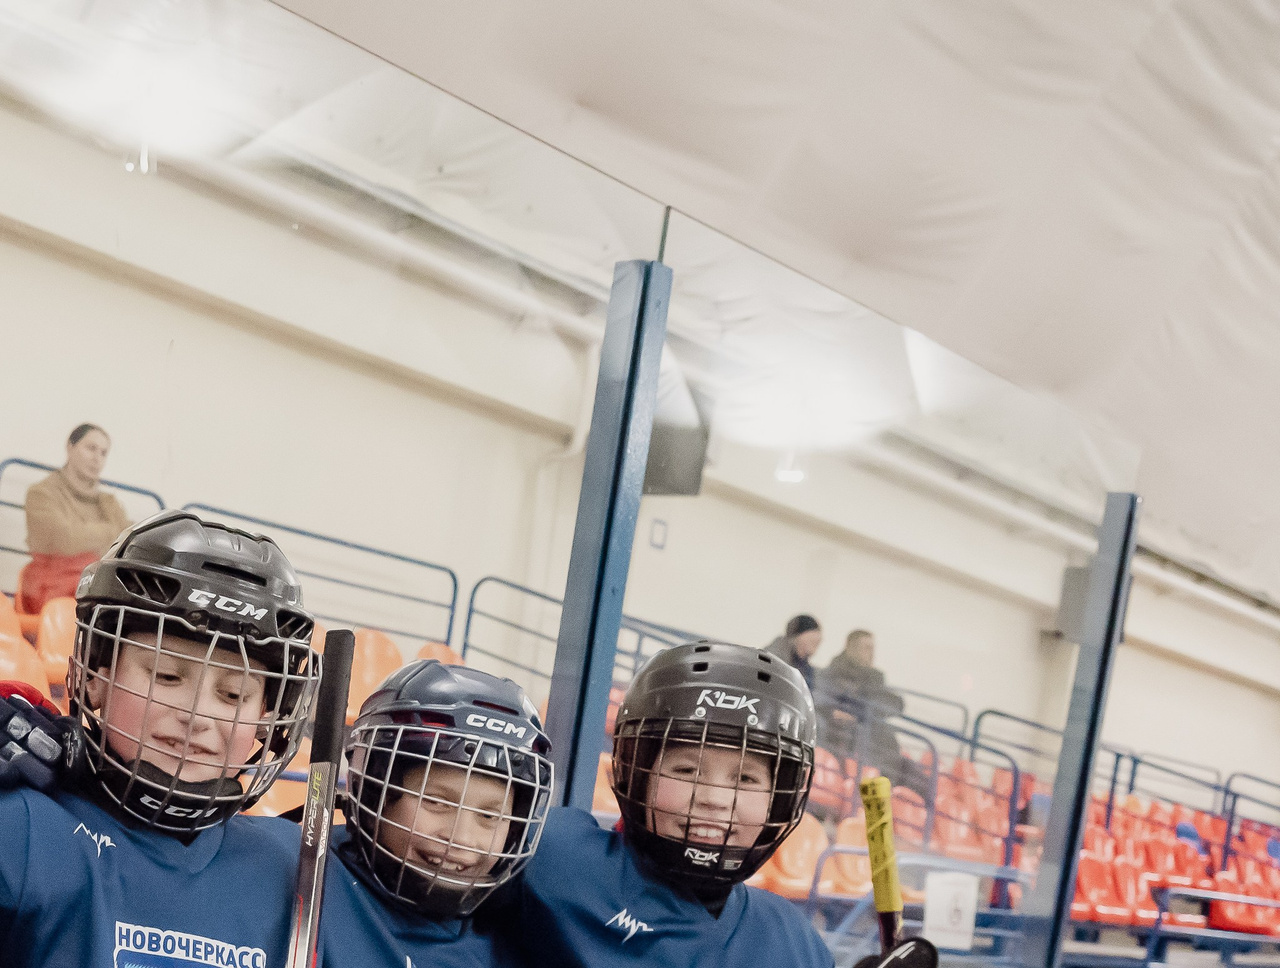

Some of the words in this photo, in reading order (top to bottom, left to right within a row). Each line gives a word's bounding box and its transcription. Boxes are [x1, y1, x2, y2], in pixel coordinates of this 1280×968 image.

[187, 588, 270, 621] CCM
[465, 713, 527, 739] CCM
[305, 771, 322, 847] HYPERLITE
